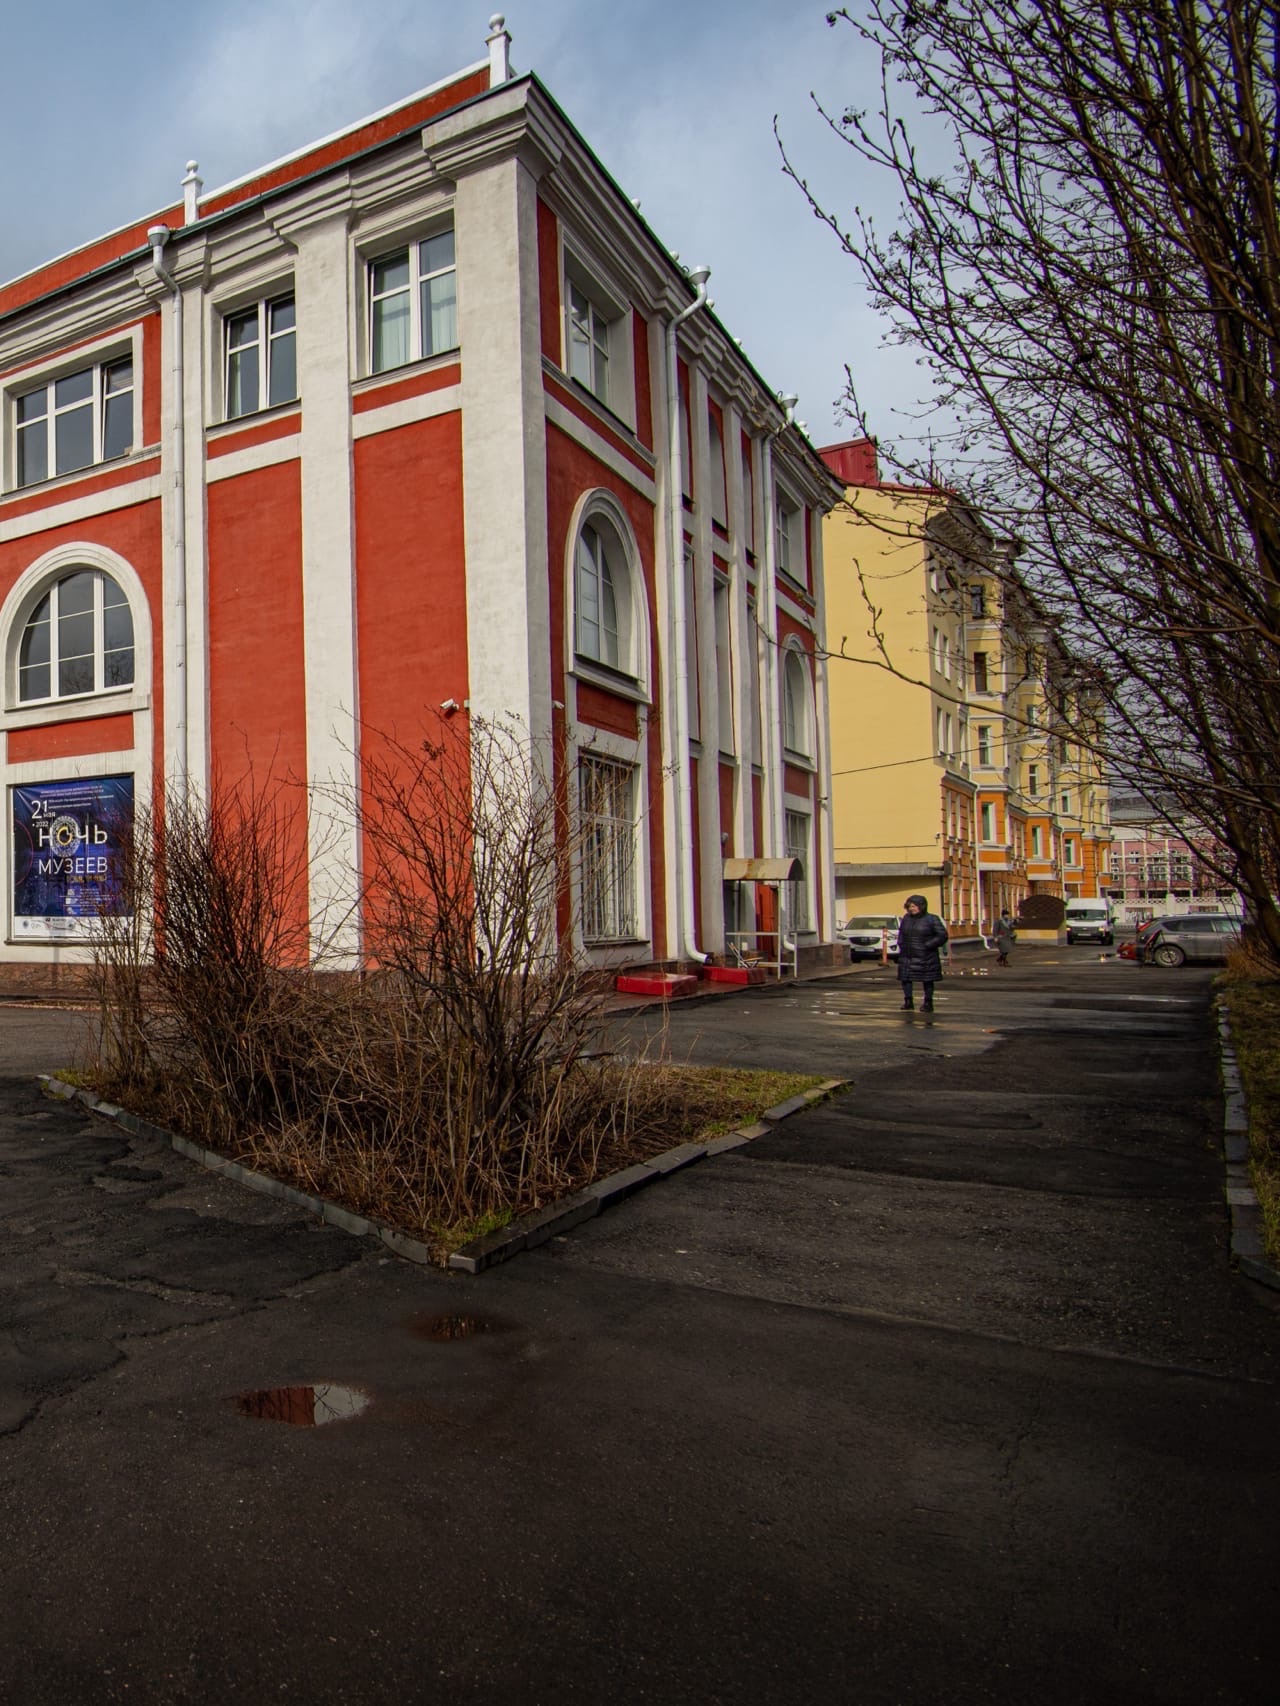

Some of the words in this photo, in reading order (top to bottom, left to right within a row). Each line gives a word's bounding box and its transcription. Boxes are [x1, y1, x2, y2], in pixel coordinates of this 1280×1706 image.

[31, 799, 48, 819] 21
[39, 824, 108, 847] НОЧЬ
[38, 857, 108, 875] МУЗЕЕВ
